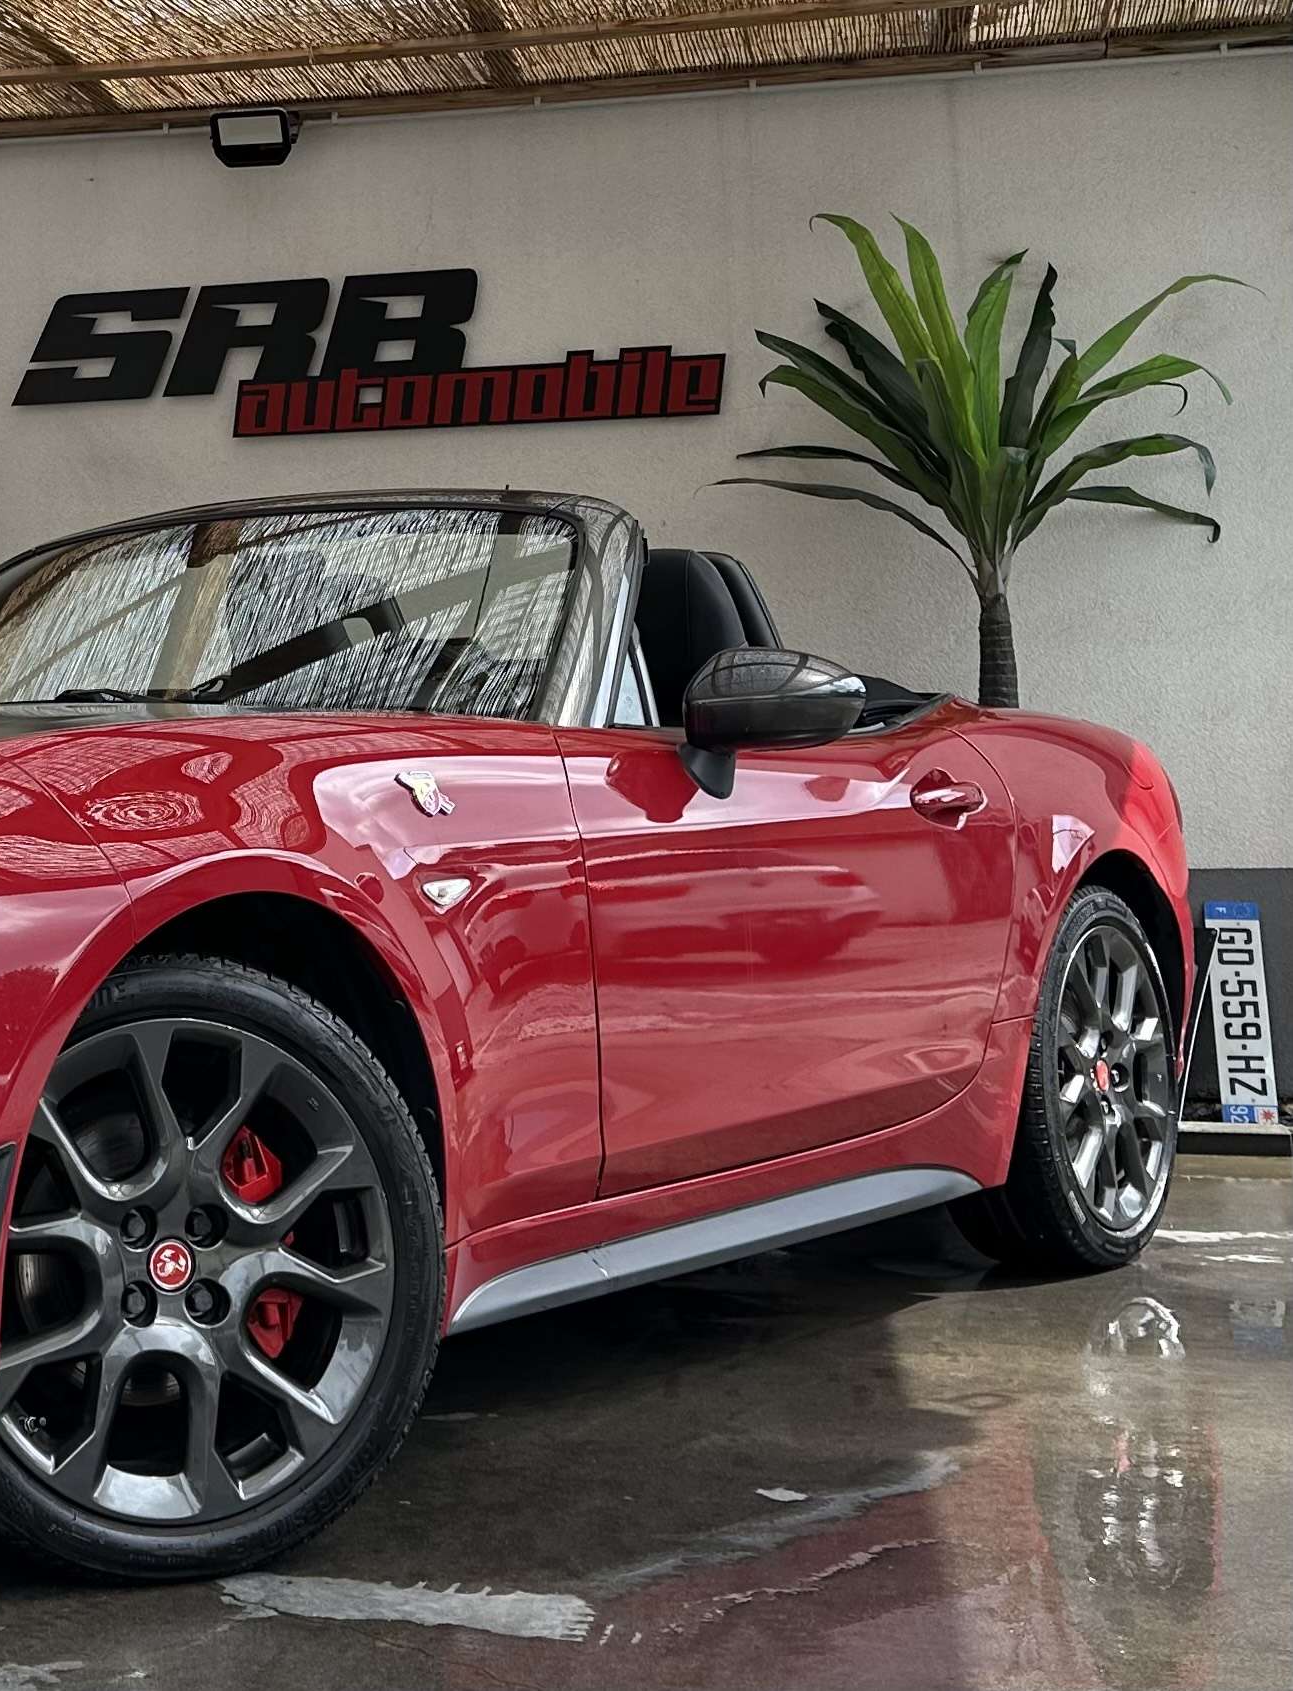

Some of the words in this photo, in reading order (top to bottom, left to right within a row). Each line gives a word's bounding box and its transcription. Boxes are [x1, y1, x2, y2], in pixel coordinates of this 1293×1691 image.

[12, 268, 478, 405] SRB
[235, 346, 724, 437] automobile
[1217, 927, 1268, 1097] GD-559-HZ
